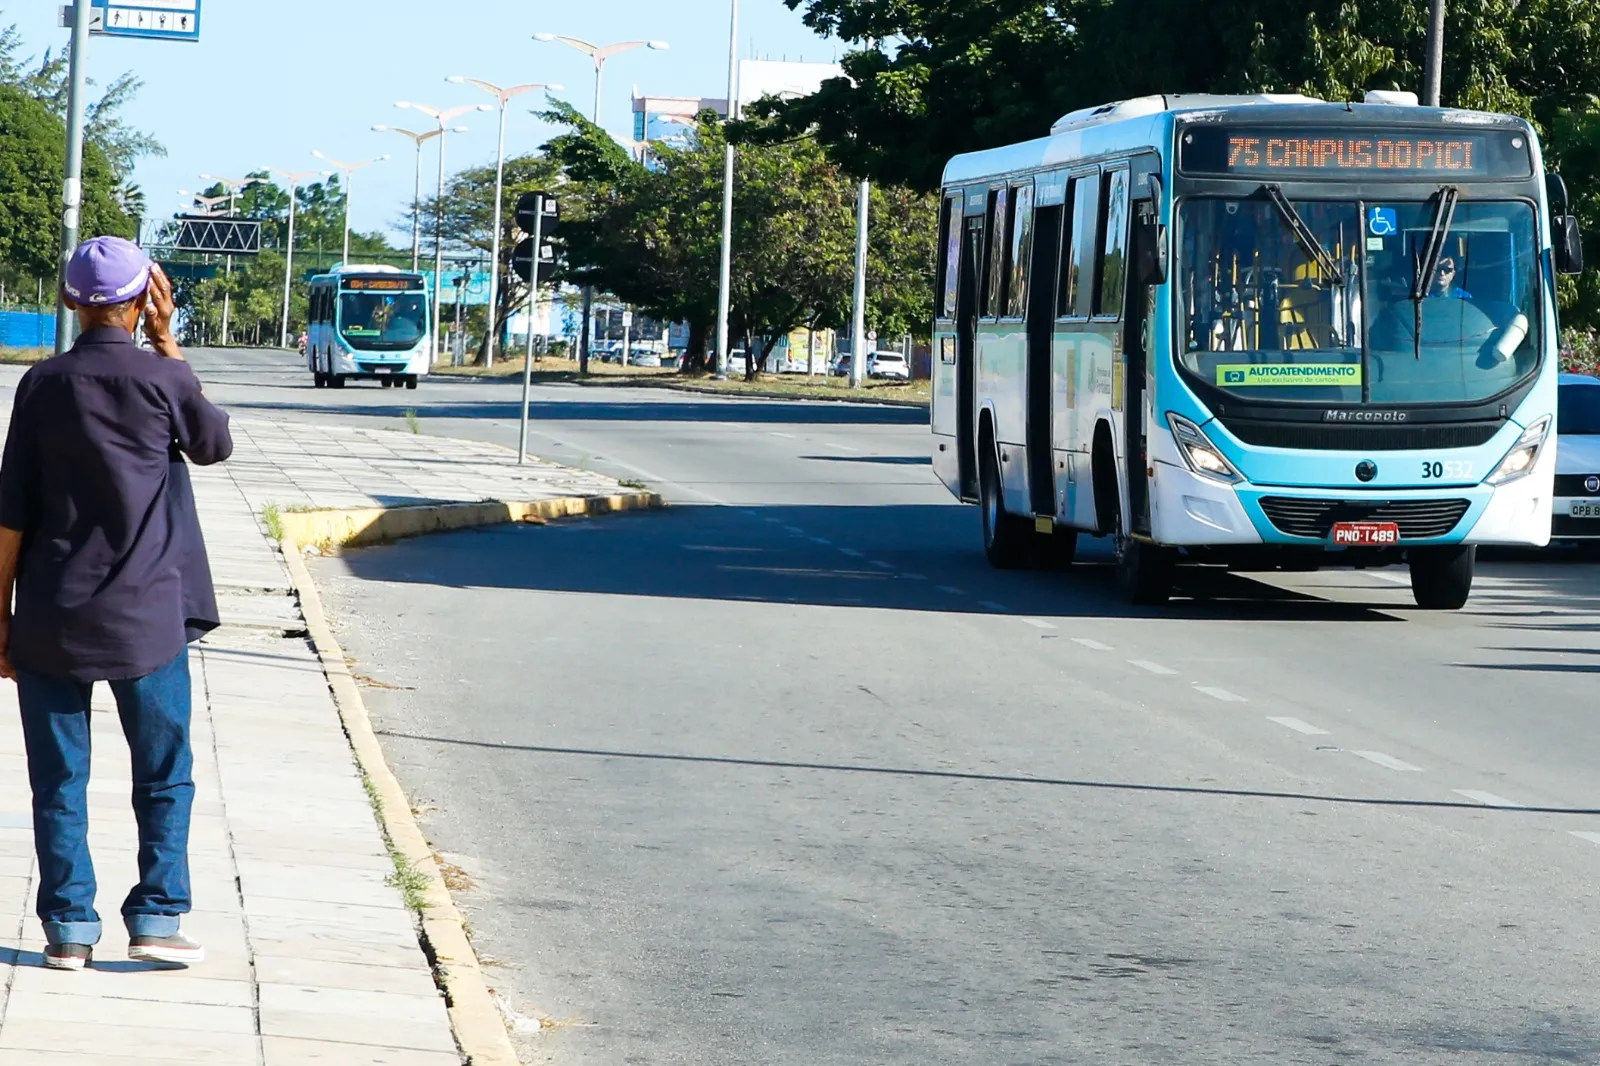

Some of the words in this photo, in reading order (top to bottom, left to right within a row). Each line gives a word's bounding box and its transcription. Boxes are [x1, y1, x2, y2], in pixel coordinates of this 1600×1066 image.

[1228, 138, 1259, 166] 75
[1266, 139, 1372, 168] CAMPUS
[1377, 140, 1412, 168] DO
[1416, 141, 1473, 169] PICI
[1248, 367, 1356, 376] AUTOATENDIMENTO
[1326, 410, 1407, 421] Marcopolo
[1421, 461, 1473, 479] 30532
